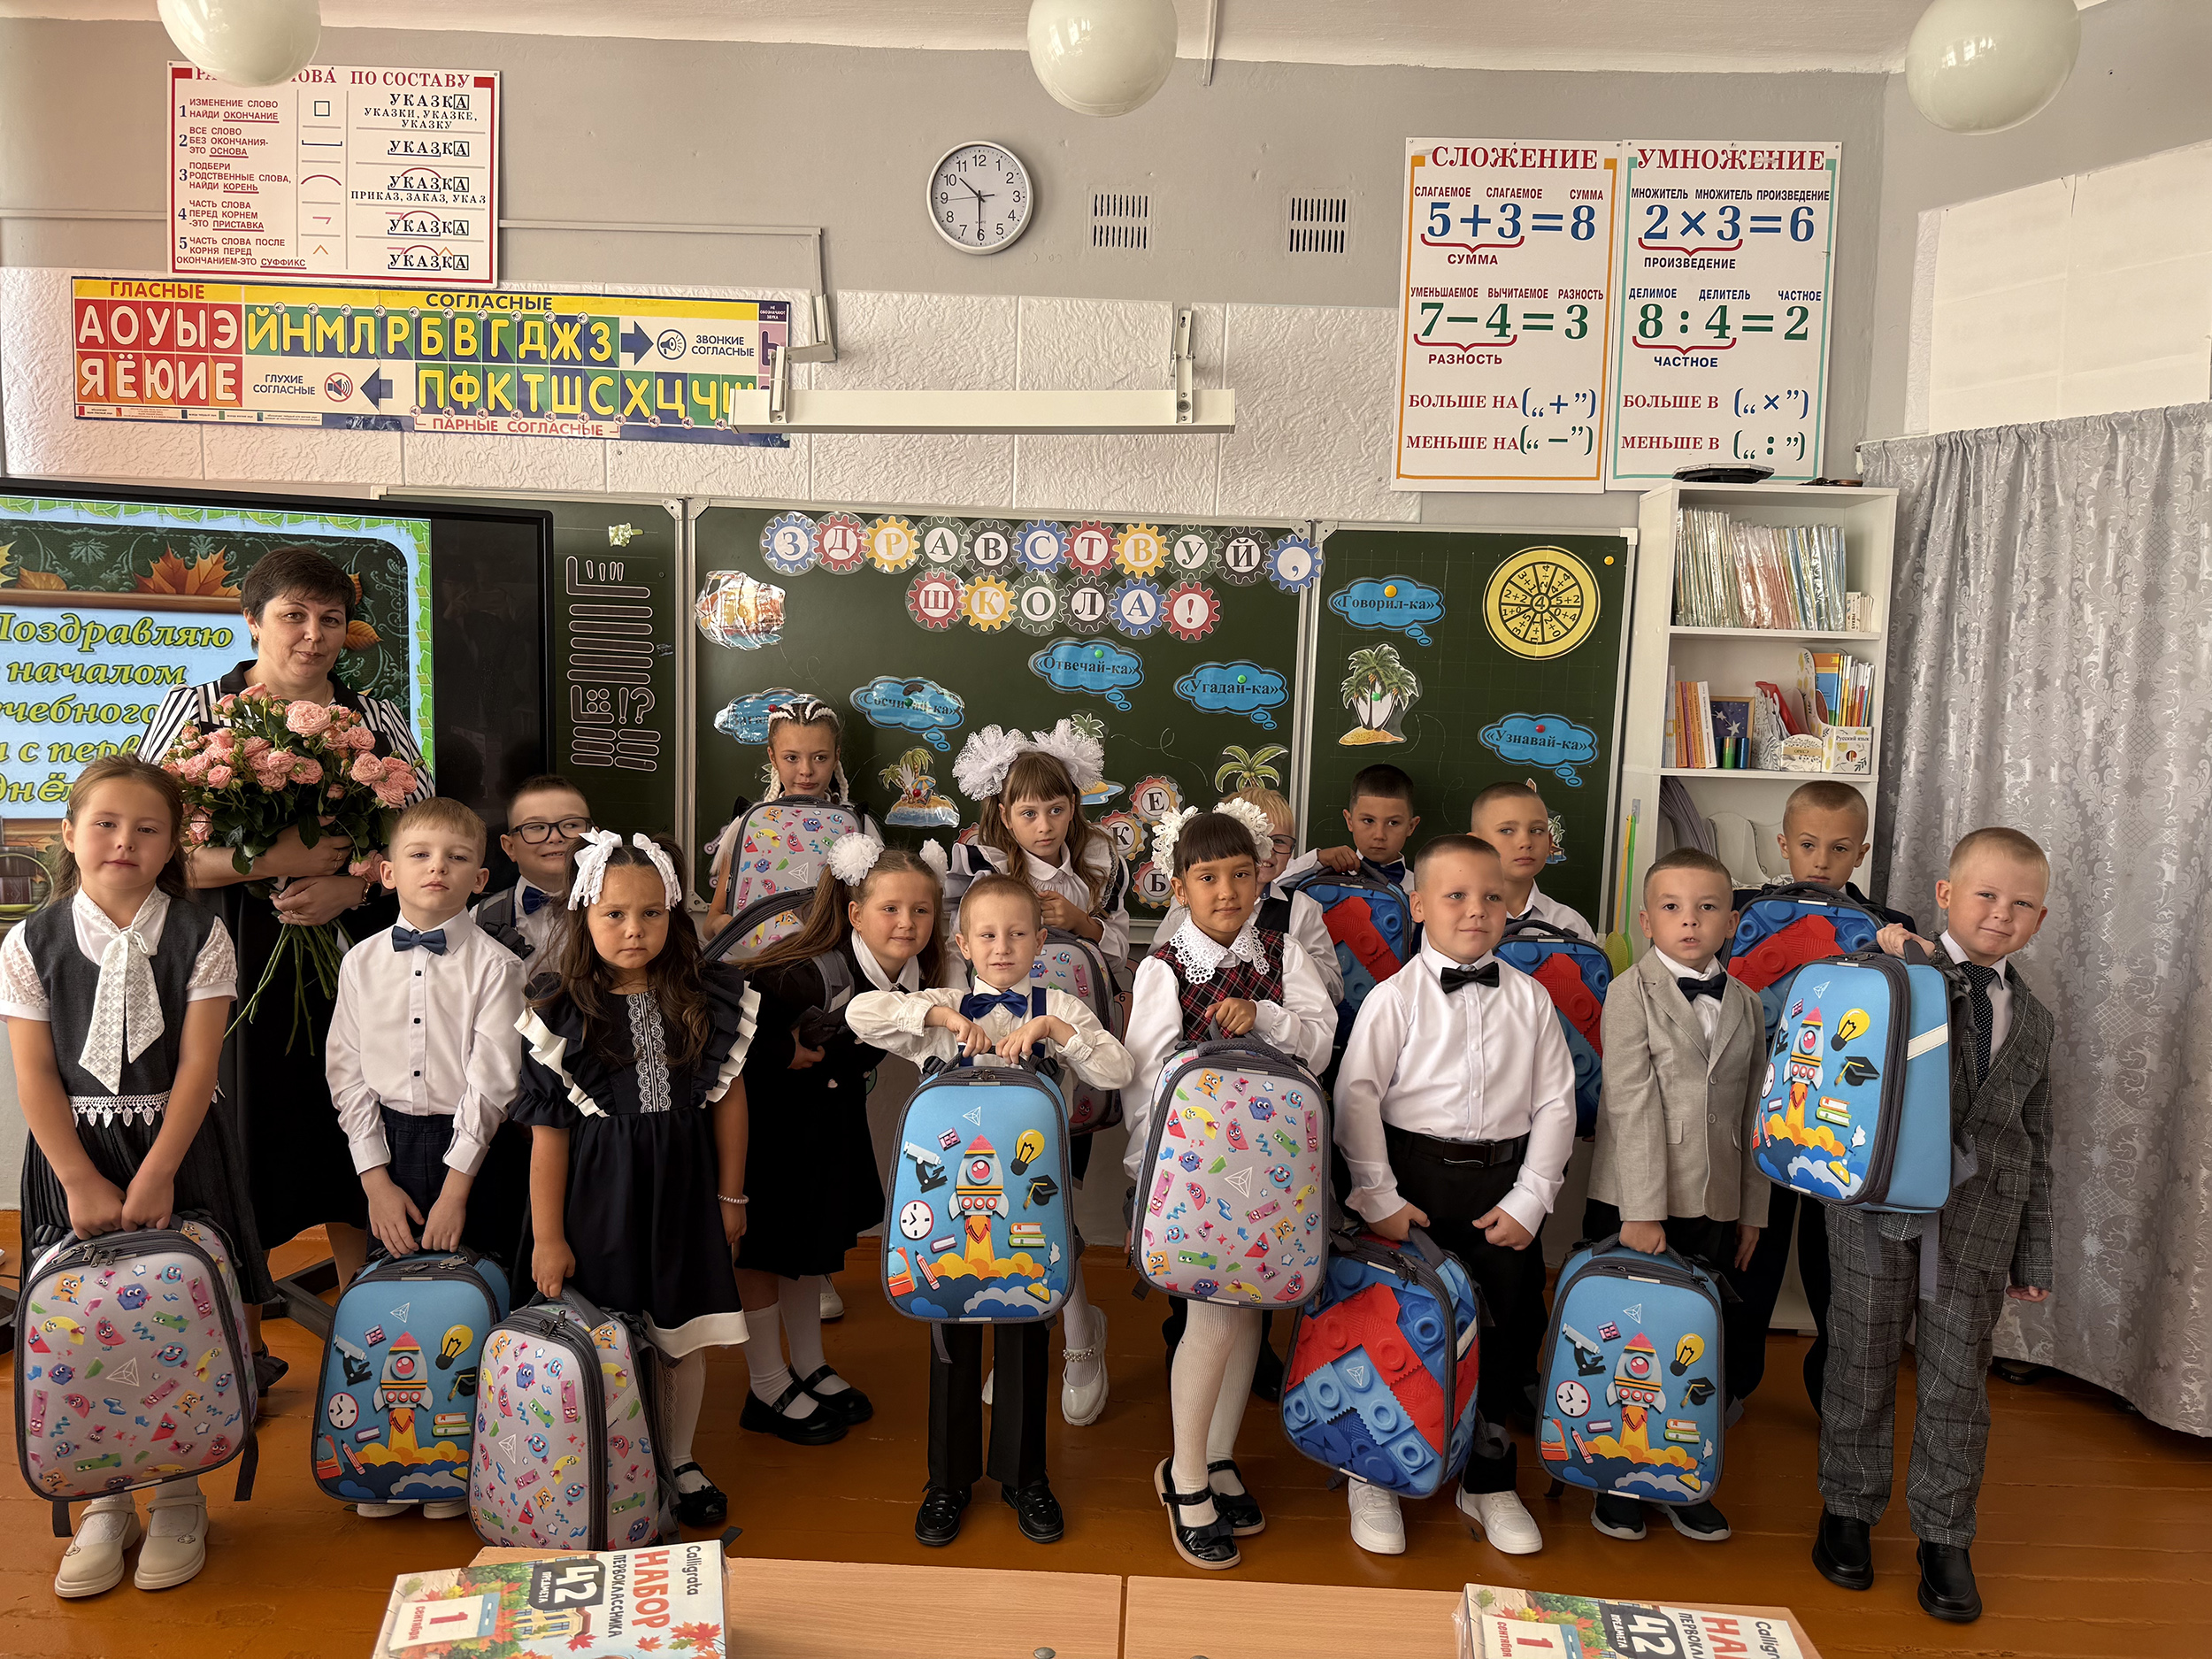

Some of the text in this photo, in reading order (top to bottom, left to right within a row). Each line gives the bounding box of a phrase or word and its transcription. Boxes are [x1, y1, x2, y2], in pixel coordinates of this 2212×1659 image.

[291, 69, 471, 88] ОВА ПО СОСТАВУ
[389, 94, 467, 108] УКАЗКА
[179, 105, 187, 117] 1
[189, 110, 278, 120] НАЙДИ ОКОНЧАНИЕ
[365, 108, 478, 121] УКАЗКИ, УКАЗКЕ,
[402, 119, 452, 129] УКАЗКУ
[179, 134, 188, 147] 2
[211, 147, 248, 156] ОСНОВА
[389, 140, 467, 156] УКАЗКА
[972, 154, 987, 166] 12
[1432, 146, 1598, 170] СЛОЖЕНИЕ
[1637, 149, 1824, 171] УМНОЖЕНИЕ
[189, 162, 230, 171] ПОДБЕРИ
[956, 160, 966, 172] 11
[996, 159, 1000, 171] 1
[179, 168, 188, 180] 3
[189, 172, 291, 183] РОДСТВЕННЫЕ СЛОВА,
[944, 173, 957, 186] 10
[1006, 172, 1014, 184] 2
[389, 176, 466, 190] УКАЗКА
[351, 191, 486, 204] ПРИКАЗ, ЗАКАЗ, УКАЗ
[941, 192, 949, 204] 9
[1012, 191, 1021, 203] 3
[1415, 186, 1603, 200] СЛАГАЕМОЕ СЛАГАЕМОЕ СУММА
[1632, 188, 1830, 202] МНОЖИТЕЛЬ МНОЖИТЕЛЬ ПРОИЗВЕДЕНИЕ
[178, 208, 187, 219] 4
[221, 211, 258, 219] КОРНЕМ
[947, 211, 954, 223] 8
[1008, 210, 1016, 221] 4
[389, 219, 466, 234] УКАЗКА
[959, 225, 967, 236] 7
[996, 223, 1003, 235] 5
[221, 237, 251, 246] СЛОВА
[977, 229, 985, 241] 6
[179, 237, 188, 250] 5
[389, 255, 466, 269] УКАЗКА
[1448, 254, 1499, 265] СУММА
[1644, 257, 1736, 270] ПРОИЗВЕДЕНИЕ
[110, 281, 205, 299] ГЛАСНЫЕ
[1410, 287, 1603, 300] УМЕНЬШАЕМОЕ ВЫЧИТАЕМОЕ РАЗНОСТЬ
[1629, 288, 1821, 301] ДЕЛИМОЕ ДЕЛИТЕЛЬ ЧАСТНОЕ
[426, 293, 553, 311] СОГЛАСНЫЕ
[695, 334, 745, 347] ЗВОНКИЕ
[692, 345, 755, 357] СОГЛАСНЫЕ
[1428, 354, 1502, 365] РАЗНОСТЬ
[1654, 356, 1718, 368] ЧАСТНОЕ
[265, 374, 303, 384] ГЛУХИЕ
[253, 384, 315, 396] СОГЛАСНЫЕ
[1409, 395, 1486, 409] БОЛЬШЕ
[1492, 396, 1518, 409] НА
[1623, 395, 1701, 409] БОЛЬШЕ
[1707, 396, 1718, 409] В
[433, 418, 603, 436] ПАРНЫЕ СОГЛАСНЫЕ
[1407, 435, 1486, 449] МЕНЬШЕ
[1493, 437, 1519, 450] НА
[1621, 435, 1702, 449] МЕНЬШЕ
[1708, 437, 1720, 449] В
[1504, 589, 1527, 603] 2+2
[1555, 595, 1580, 605] 5+2
[1334, 596, 1435, 611] «Говорил-ка»
[1534, 596, 1545, 610] 4
[1035, 657, 1137, 676] «Отвечай-ка»
[7, 662, 187, 685] началом
[0, 694, 158, 724] чебного
[1486, 731, 1587, 751] «Узнавай-ка»
[19, 742, 39, 763] с
[1147, 792, 1164, 812] Е
[1111, 826, 1130, 846] К
[1150, 874, 1166, 892] Б
[681, 1545, 703, 1595] Calligrata
[538, 1571, 551, 1603] ПРЕДМЕТА
[554, 1565, 600, 1603] 42
[632, 1550, 671, 1628] НАБОР
[608, 1554, 626, 1638] ПЕРВОКЛАССНИКА
[408, 1606, 426, 1640] сентября
[430, 1612, 469, 1624] 1
[1610, 1614, 1628, 1647] ПРЕДМЕТА
[1628, 1614, 1676, 1655] 42
[1497, 1621, 1513, 1657] сентября
[1517, 1637, 1554, 1648] 1
[1701, 1617, 1750, 1659] НА
